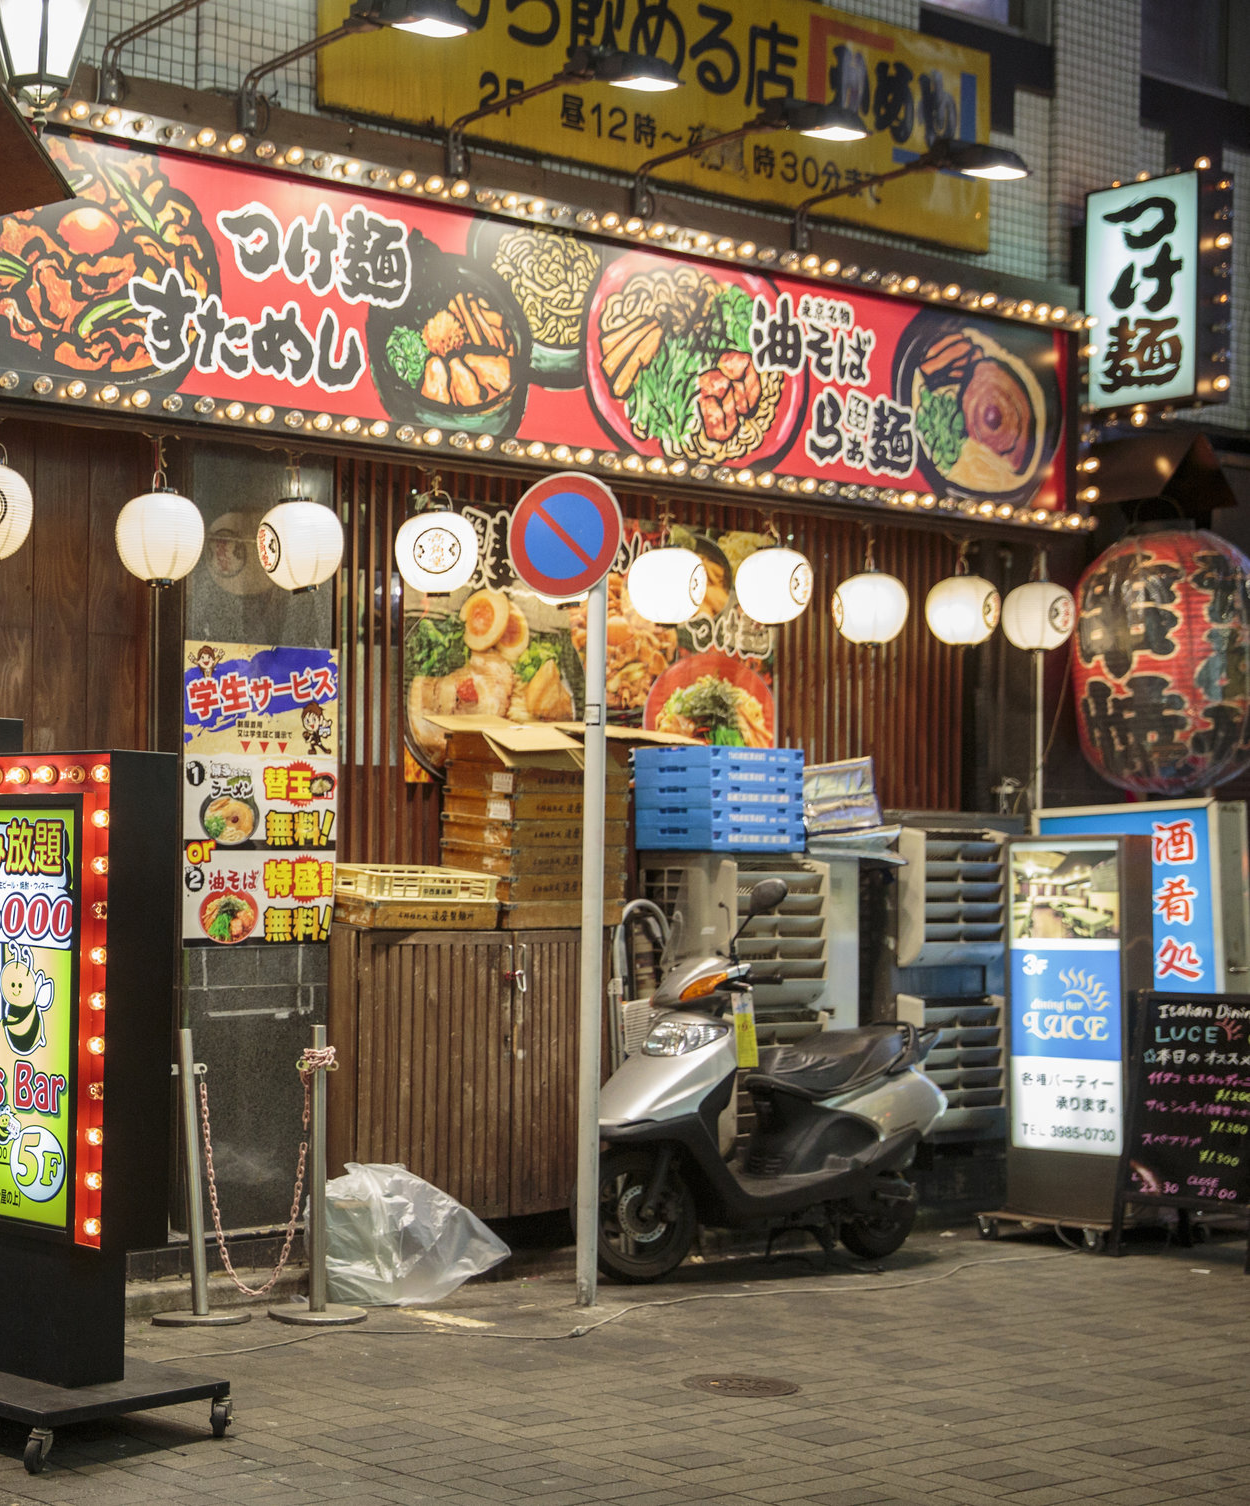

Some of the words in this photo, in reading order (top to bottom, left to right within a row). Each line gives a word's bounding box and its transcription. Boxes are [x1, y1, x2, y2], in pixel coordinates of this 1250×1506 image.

[219, 202, 412, 307] つけ麺
[1100, 196, 1183, 395] つけ麺
[129, 269, 365, 392] すためし
[752, 293, 875, 385] 油そば
[187, 667, 337, 720] 学生サービス
[211, 780, 254, 799] ラーメン
[264, 766, 314, 800] 替玉
[186, 839, 217, 865] or
[209, 869, 259, 890] 油そば
[263, 859, 320, 898] 特盛
[1152, 819, 1204, 982] 酒肴処
[1022, 953, 1048, 976] 3F
[1022, 1011, 1110, 1041] LUCE
[1158, 1003, 1212, 1019] Italian
[1154, 1025, 1220, 1044] LUCE
[13, 1060, 66, 1114] Bar
[1050, 1125, 1116, 1142] 3985-0730
[16, 1132, 62, 1187] 5F
